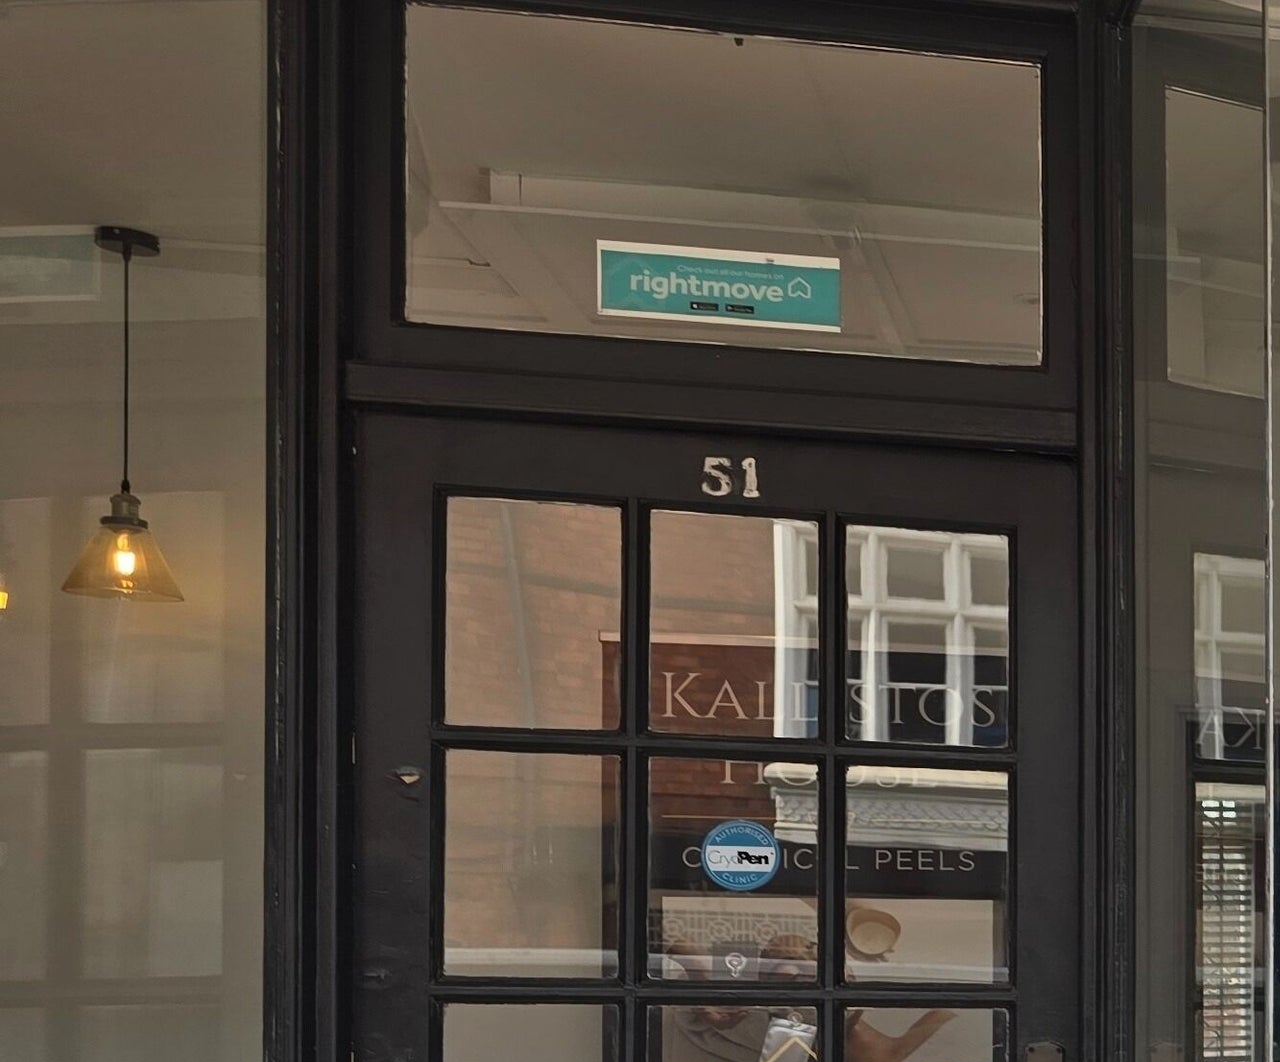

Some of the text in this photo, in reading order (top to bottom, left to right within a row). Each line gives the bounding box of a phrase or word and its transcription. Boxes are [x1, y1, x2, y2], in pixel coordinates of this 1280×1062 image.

[630, 270, 783, 302] rightmove
[700, 456, 761, 499] 51
[714, 827, 768, 845] AUTHORISED
[876, 850, 975, 871] PEELS
[721, 872, 758, 884] CLINIC
